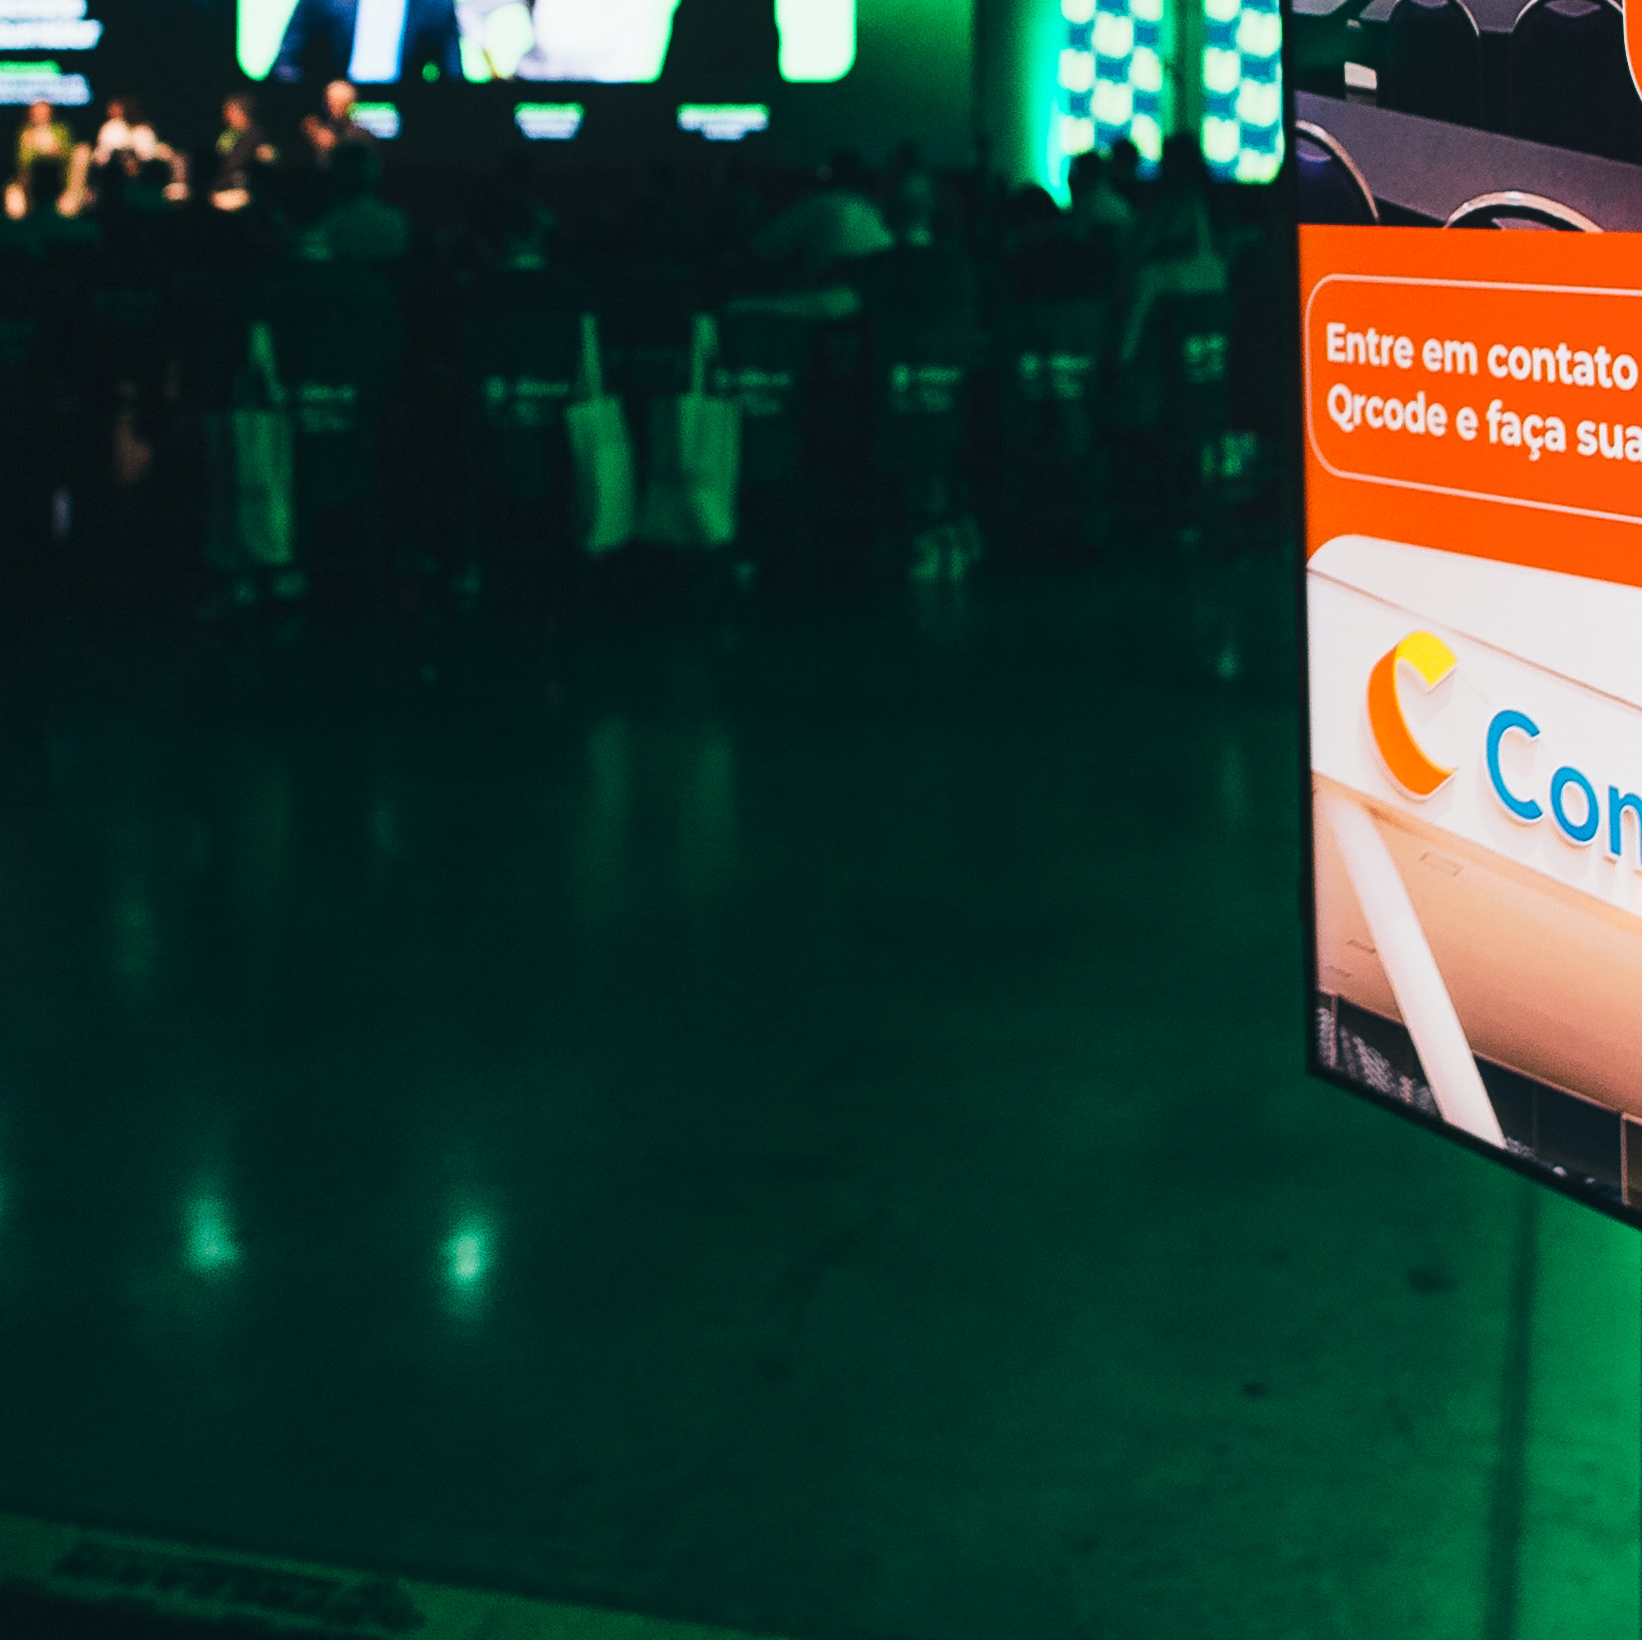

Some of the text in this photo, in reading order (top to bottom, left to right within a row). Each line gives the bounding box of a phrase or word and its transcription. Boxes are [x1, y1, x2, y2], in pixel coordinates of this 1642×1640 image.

[1325, 322, 1414, 369] Entre
[1422, 338, 1478, 376] em
[1487, 342, 1639, 392] contato
[1327, 383, 1448, 437] Qrcode
[1455, 406, 1479, 441] e
[1485, 398, 1567, 462] faça
